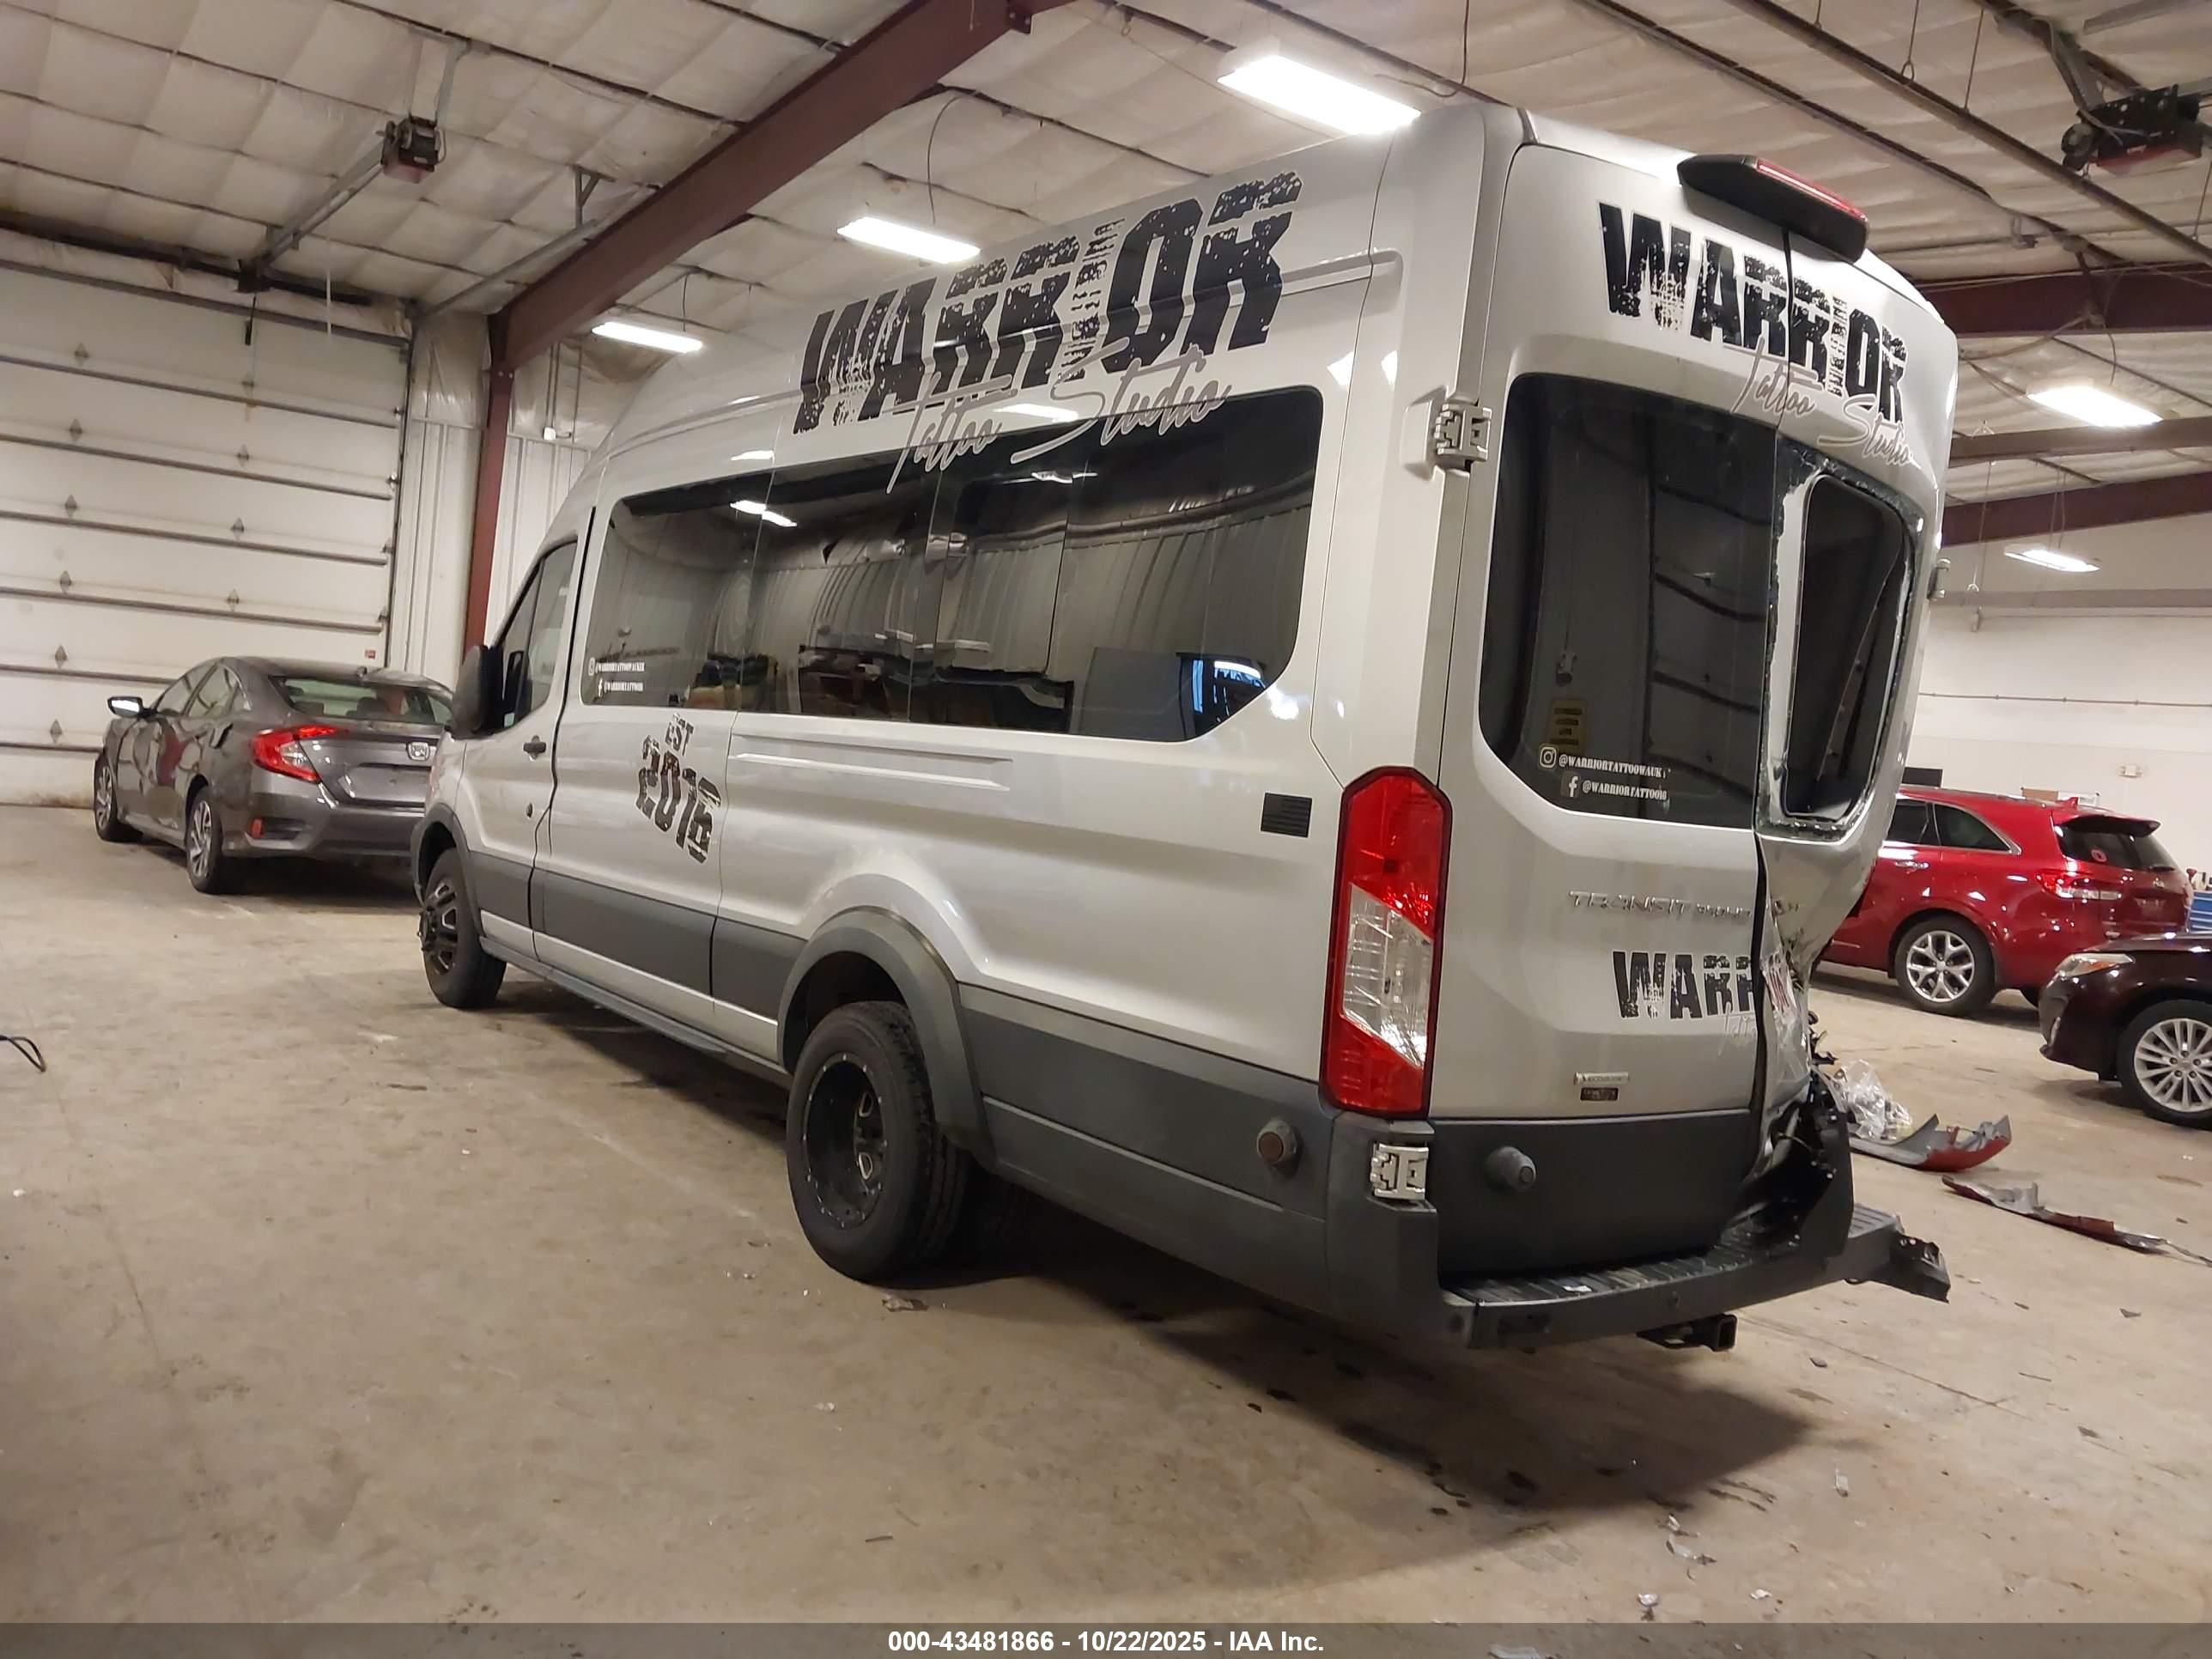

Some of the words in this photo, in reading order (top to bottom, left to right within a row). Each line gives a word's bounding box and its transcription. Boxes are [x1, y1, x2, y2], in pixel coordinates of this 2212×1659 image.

[793, 171, 1304, 434] WARRIOR
[1598, 200, 1907, 423] WARRIOR
[886, 370, 1018, 493] Tattoo
[1011, 337, 1231, 464] Studio
[1723, 337, 1823, 416] Tattoo
[1816, 393, 1917, 465] Studio
[664, 712, 695, 757] EST
[1558, 753, 1672, 779] @WARRIORTATTOOWAUK
[635, 735, 722, 864] 2016
[1569, 890, 1687, 915] TRANSIT
